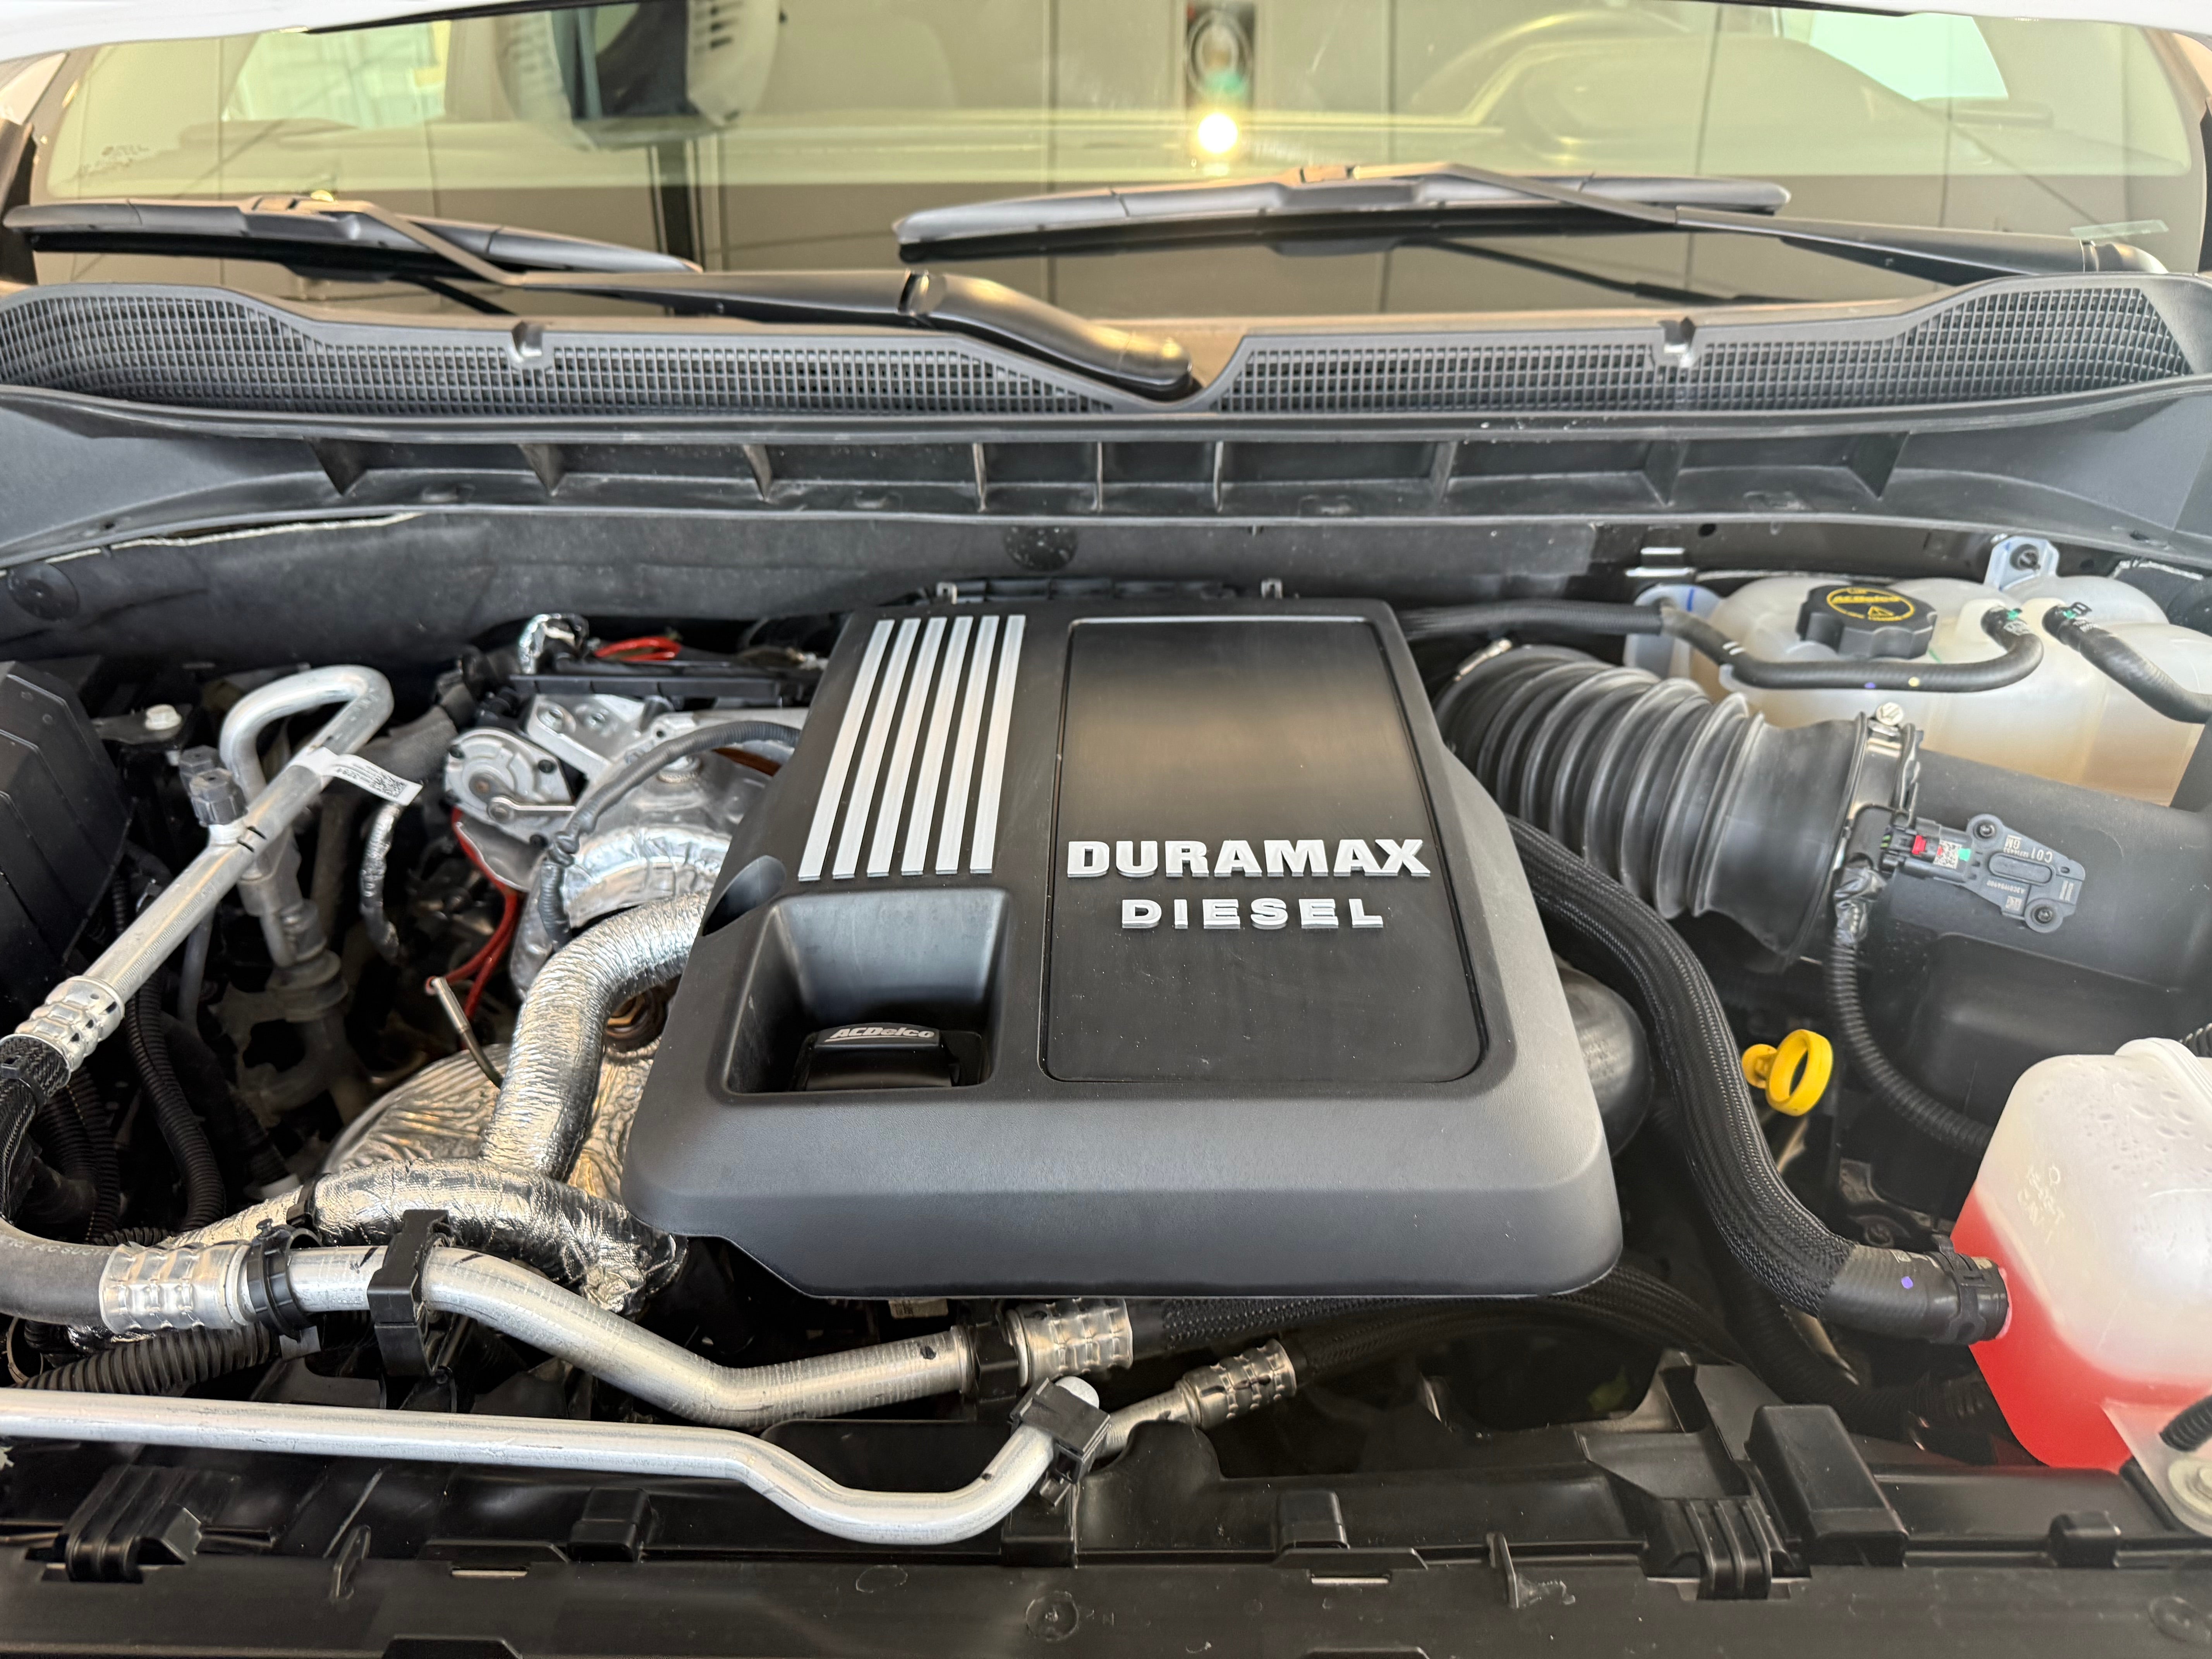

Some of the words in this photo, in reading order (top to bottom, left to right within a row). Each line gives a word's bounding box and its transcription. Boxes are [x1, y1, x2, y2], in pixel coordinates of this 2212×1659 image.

[2004, 835, 2021, 849] GM
[1068, 840, 1431, 877] DURAMAX
[1122, 898, 1383, 929] DIESEL
[830, 1027, 935, 1038] ACDelco
